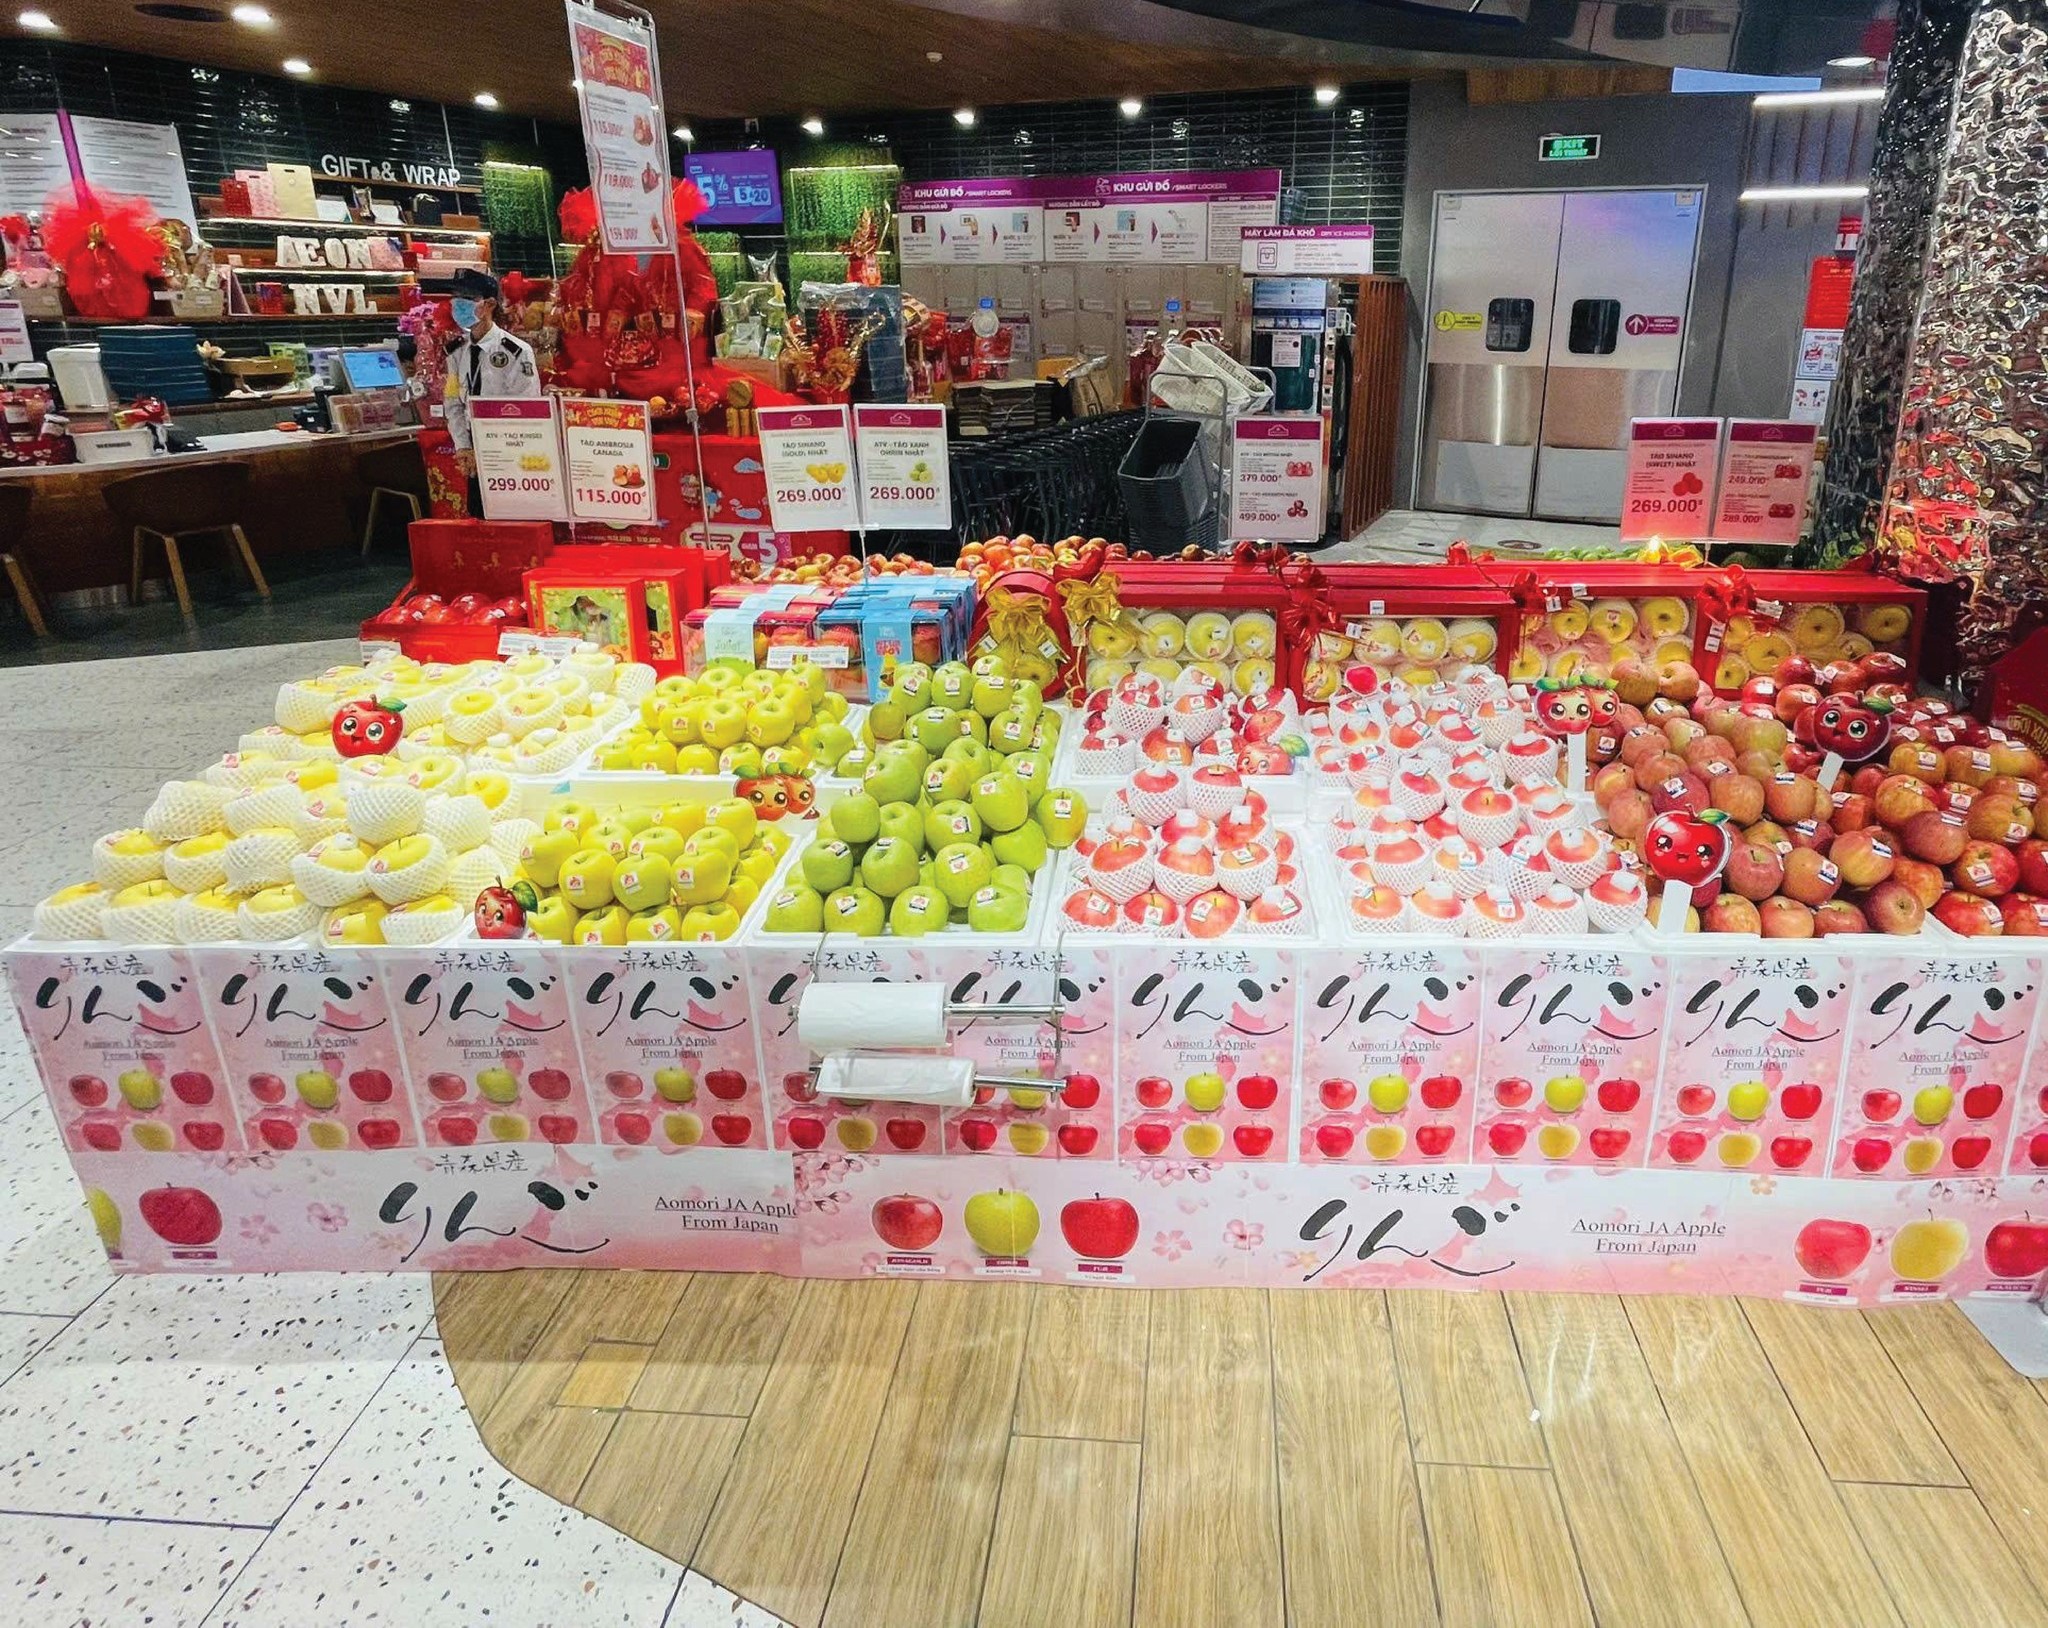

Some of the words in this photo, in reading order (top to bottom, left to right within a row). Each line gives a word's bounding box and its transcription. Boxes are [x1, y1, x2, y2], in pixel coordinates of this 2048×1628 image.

[1553, 138, 1585, 149] EXIT
[321, 154, 371, 179] GIFT
[381, 161, 398, 182] &
[402, 163, 461, 188] WRAP
[914, 188, 933, 199] KHU
[1113, 183, 1135, 192] KHU
[1244, 228, 1263, 237] MÁY
[1263, 228, 1282, 237] LÀM
[1296, 227, 1316, 237] KHÔ
[275, 235, 374, 269] AEON
[288, 283, 378, 316] NVL
[592, 448, 624, 457] CANADA
[36, 976, 201, 1041] りんご
[221, 973, 387, 1038] りんご
[405, 973, 566, 1037] りんご
[586, 972, 747, 1037] りんご
[1132, 973, 1289, 1040] りんご
[1314, 974, 1474, 1042] りんご
[1498, 973, 1661, 1042] りんご
[1685, 980, 1846, 1048] りんご
[1870, 982, 2034, 1050] りんご
[488, 1036, 504, 1048] JA
[625, 1036, 665, 1047] Aomori
[667, 1036, 683, 1047] JA
[685, 1036, 717, 1048] Apple
[985, 1035, 1025, 1047] Aomori
[1027, 1035, 1042, 1047] JA
[1163, 1039, 1205, 1050] Aomori
[1207, 1039, 1222, 1050] JA
[1224, 1039, 1257, 1051] Apple
[1348, 1041, 1390, 1051] Aomori
[1392, 1041, 1408, 1051] JA
[1409, 1041, 1442, 1052] Apple
[463, 1049, 494, 1060] From
[641, 1049, 671, 1059] From
[1000, 1049, 1029, 1060] From
[1527, 1042, 1570, 1053] Aomori
[1572, 1042, 1588, 1053] JA
[1589, 1042, 1623, 1055] Apple
[1711, 1046, 1754, 1057] Aomori
[1756, 1046, 1772, 1058] JA
[1773, 1046, 1806, 1058] Apple
[1178, 1052, 1208, 1062] From
[1211, 1051, 1241, 1063] Japan
[1363, 1053, 1393, 1064] From
[1395, 1053, 1426, 1065] Japan
[1540, 1054, 1572, 1065] From
[1574, 1055, 1605, 1067] Japan
[1899, 1051, 1941, 1062] Aomori
[1724, 1059, 1755, 1071] From
[1758, 1059, 1789, 1071] Japan
[1912, 1064, 1942, 1076] From
[655, 1196, 720, 1211] Aomori
[723, 1197, 748, 1213] JA
[379, 1181, 611, 1263] りんご
[682, 1214, 728, 1230] From
[732, 1216, 780, 1234] Japan
[1572, 1218, 1642, 1235] Aomori
[1644, 1219, 1671, 1235] JA
[1675, 1220, 1727, 1237] Apple
[1299, 1198, 1521, 1282] りんご
[1596, 1237, 1643, 1254] From
[1647, 1239, 1698, 1256] Japan
